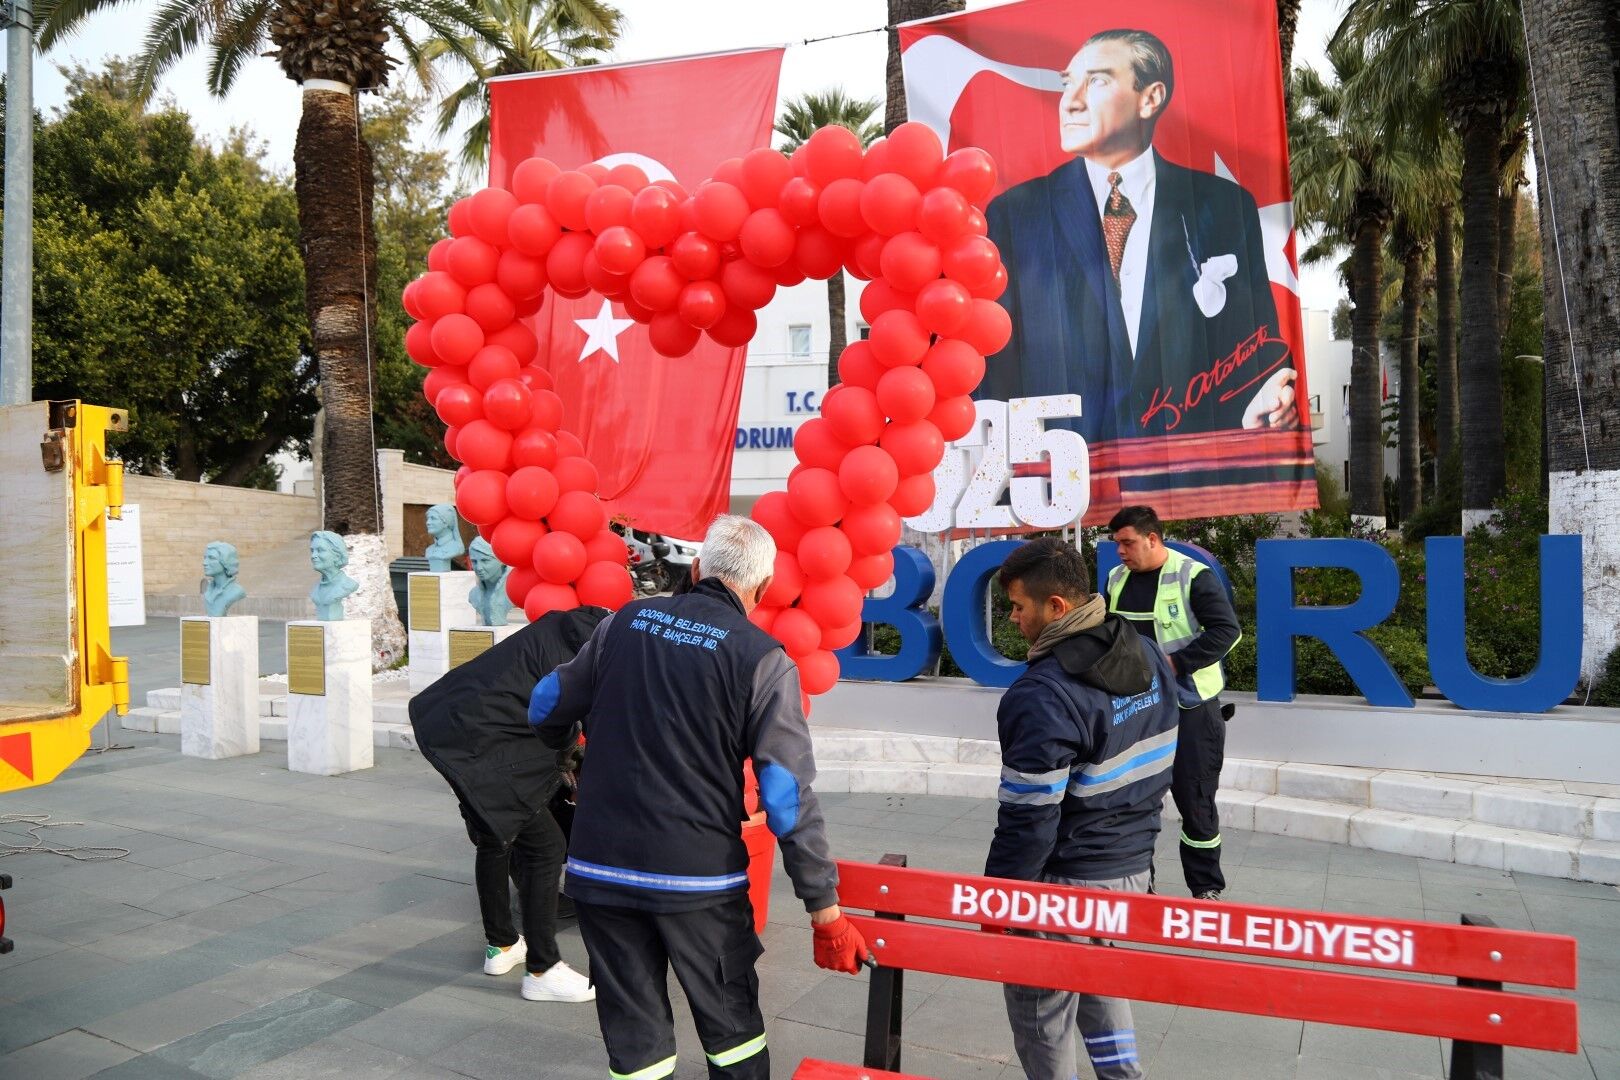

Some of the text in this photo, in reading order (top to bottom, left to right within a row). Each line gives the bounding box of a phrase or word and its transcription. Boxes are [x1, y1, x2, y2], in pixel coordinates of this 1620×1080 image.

[786, 391, 821, 412] T.C.
[630, 619, 650, 631] PARK
[650, 623, 661, 635] VE
[663, 629, 703, 645] BAHÇELER
[637, 609, 729, 640] BODRUM BELEDİYESİ
[951, 882, 1129, 936] BODRUM
